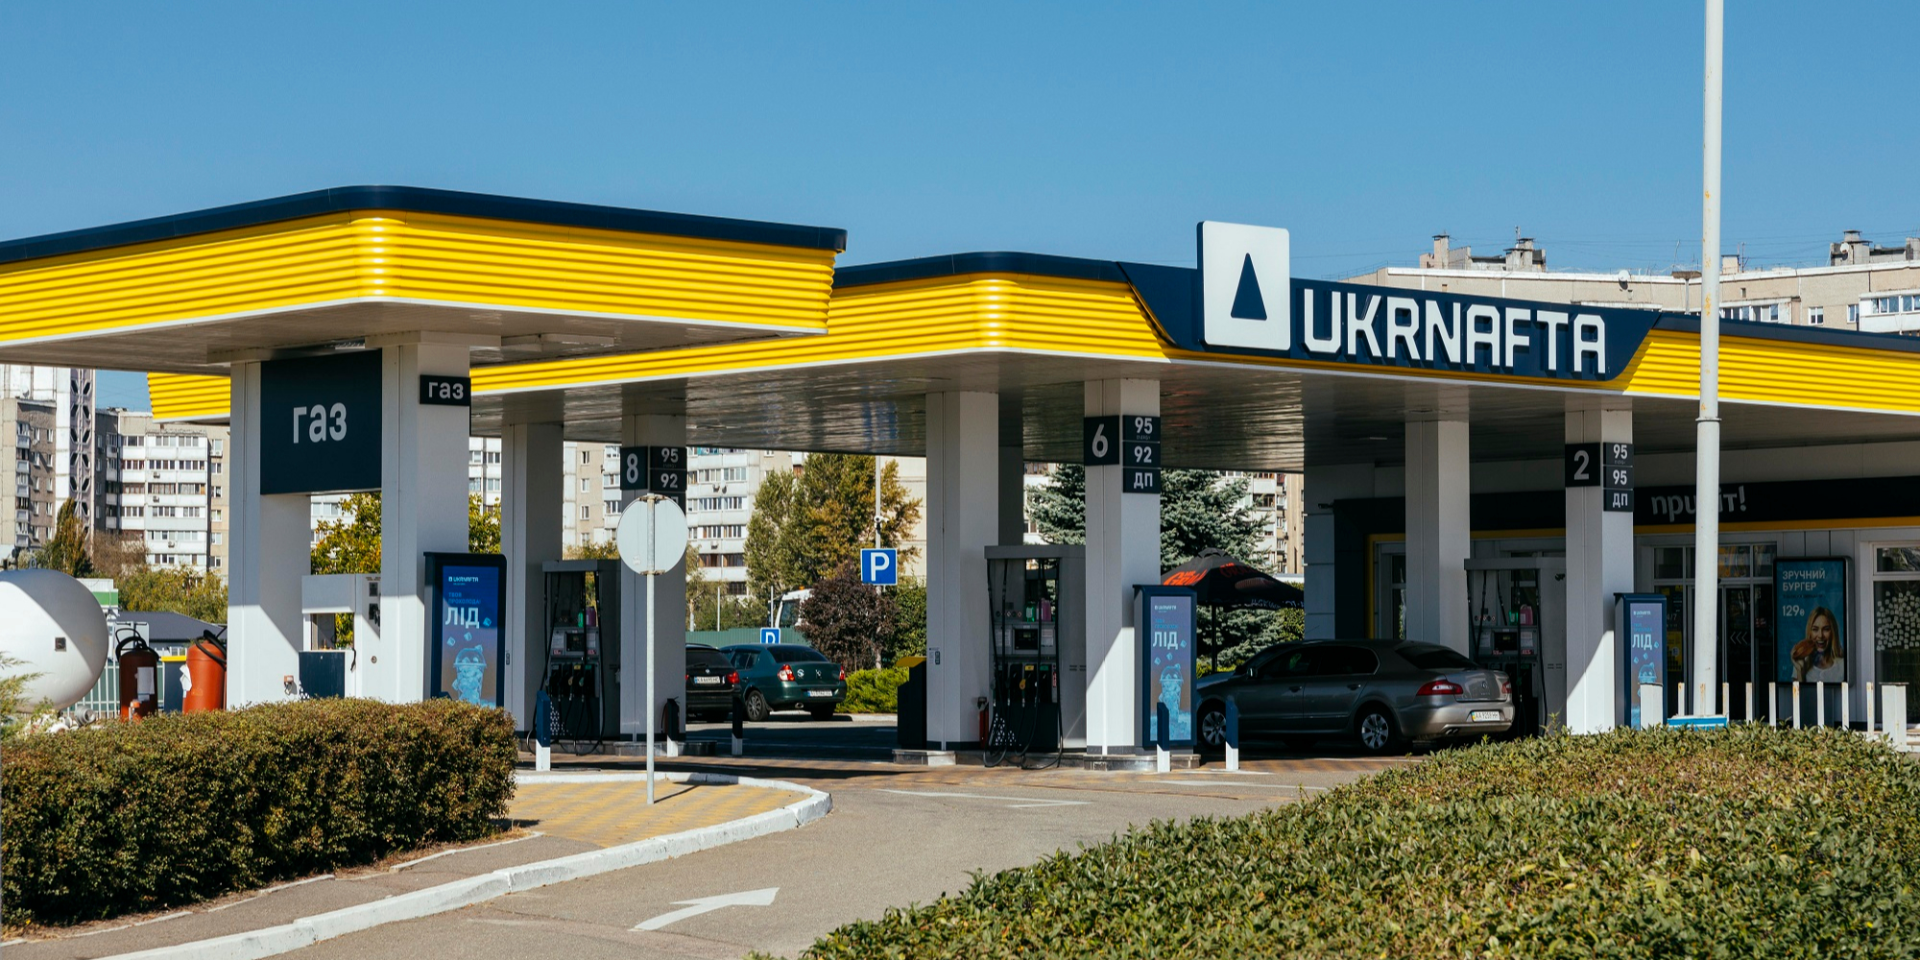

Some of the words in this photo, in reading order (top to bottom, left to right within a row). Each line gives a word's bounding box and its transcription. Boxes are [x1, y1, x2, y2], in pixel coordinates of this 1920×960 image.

[1304, 288, 1605, 373] UKRNAFTA
[428, 382, 463, 399] газ
[293, 402, 347, 443] газ
[1134, 417, 1153, 434] 95
[1092, 423, 1108, 458] 6
[661, 448, 679, 463] 95
[1134, 446, 1152, 463] 92
[1613, 444, 1628, 459] 95
[626, 453, 639, 484] 8
[1574, 450, 1589, 480] 2
[660, 473, 678, 488] 92
[1133, 472, 1153, 489] ДП
[1612, 469, 1627, 485] 95
[1612, 493, 1628, 508] ДП
[1651, 485, 1747, 523] приіт!
[870, 552, 890, 581] P
[1782, 568, 1825, 580] ЗРУЧНИЙ
[1782, 582, 1817, 591] БУРГЕР
[445, 607, 479, 629] ЛІД
[1152, 631, 1179, 650] ЛІД
[1632, 634, 1652, 650] ЛІД
